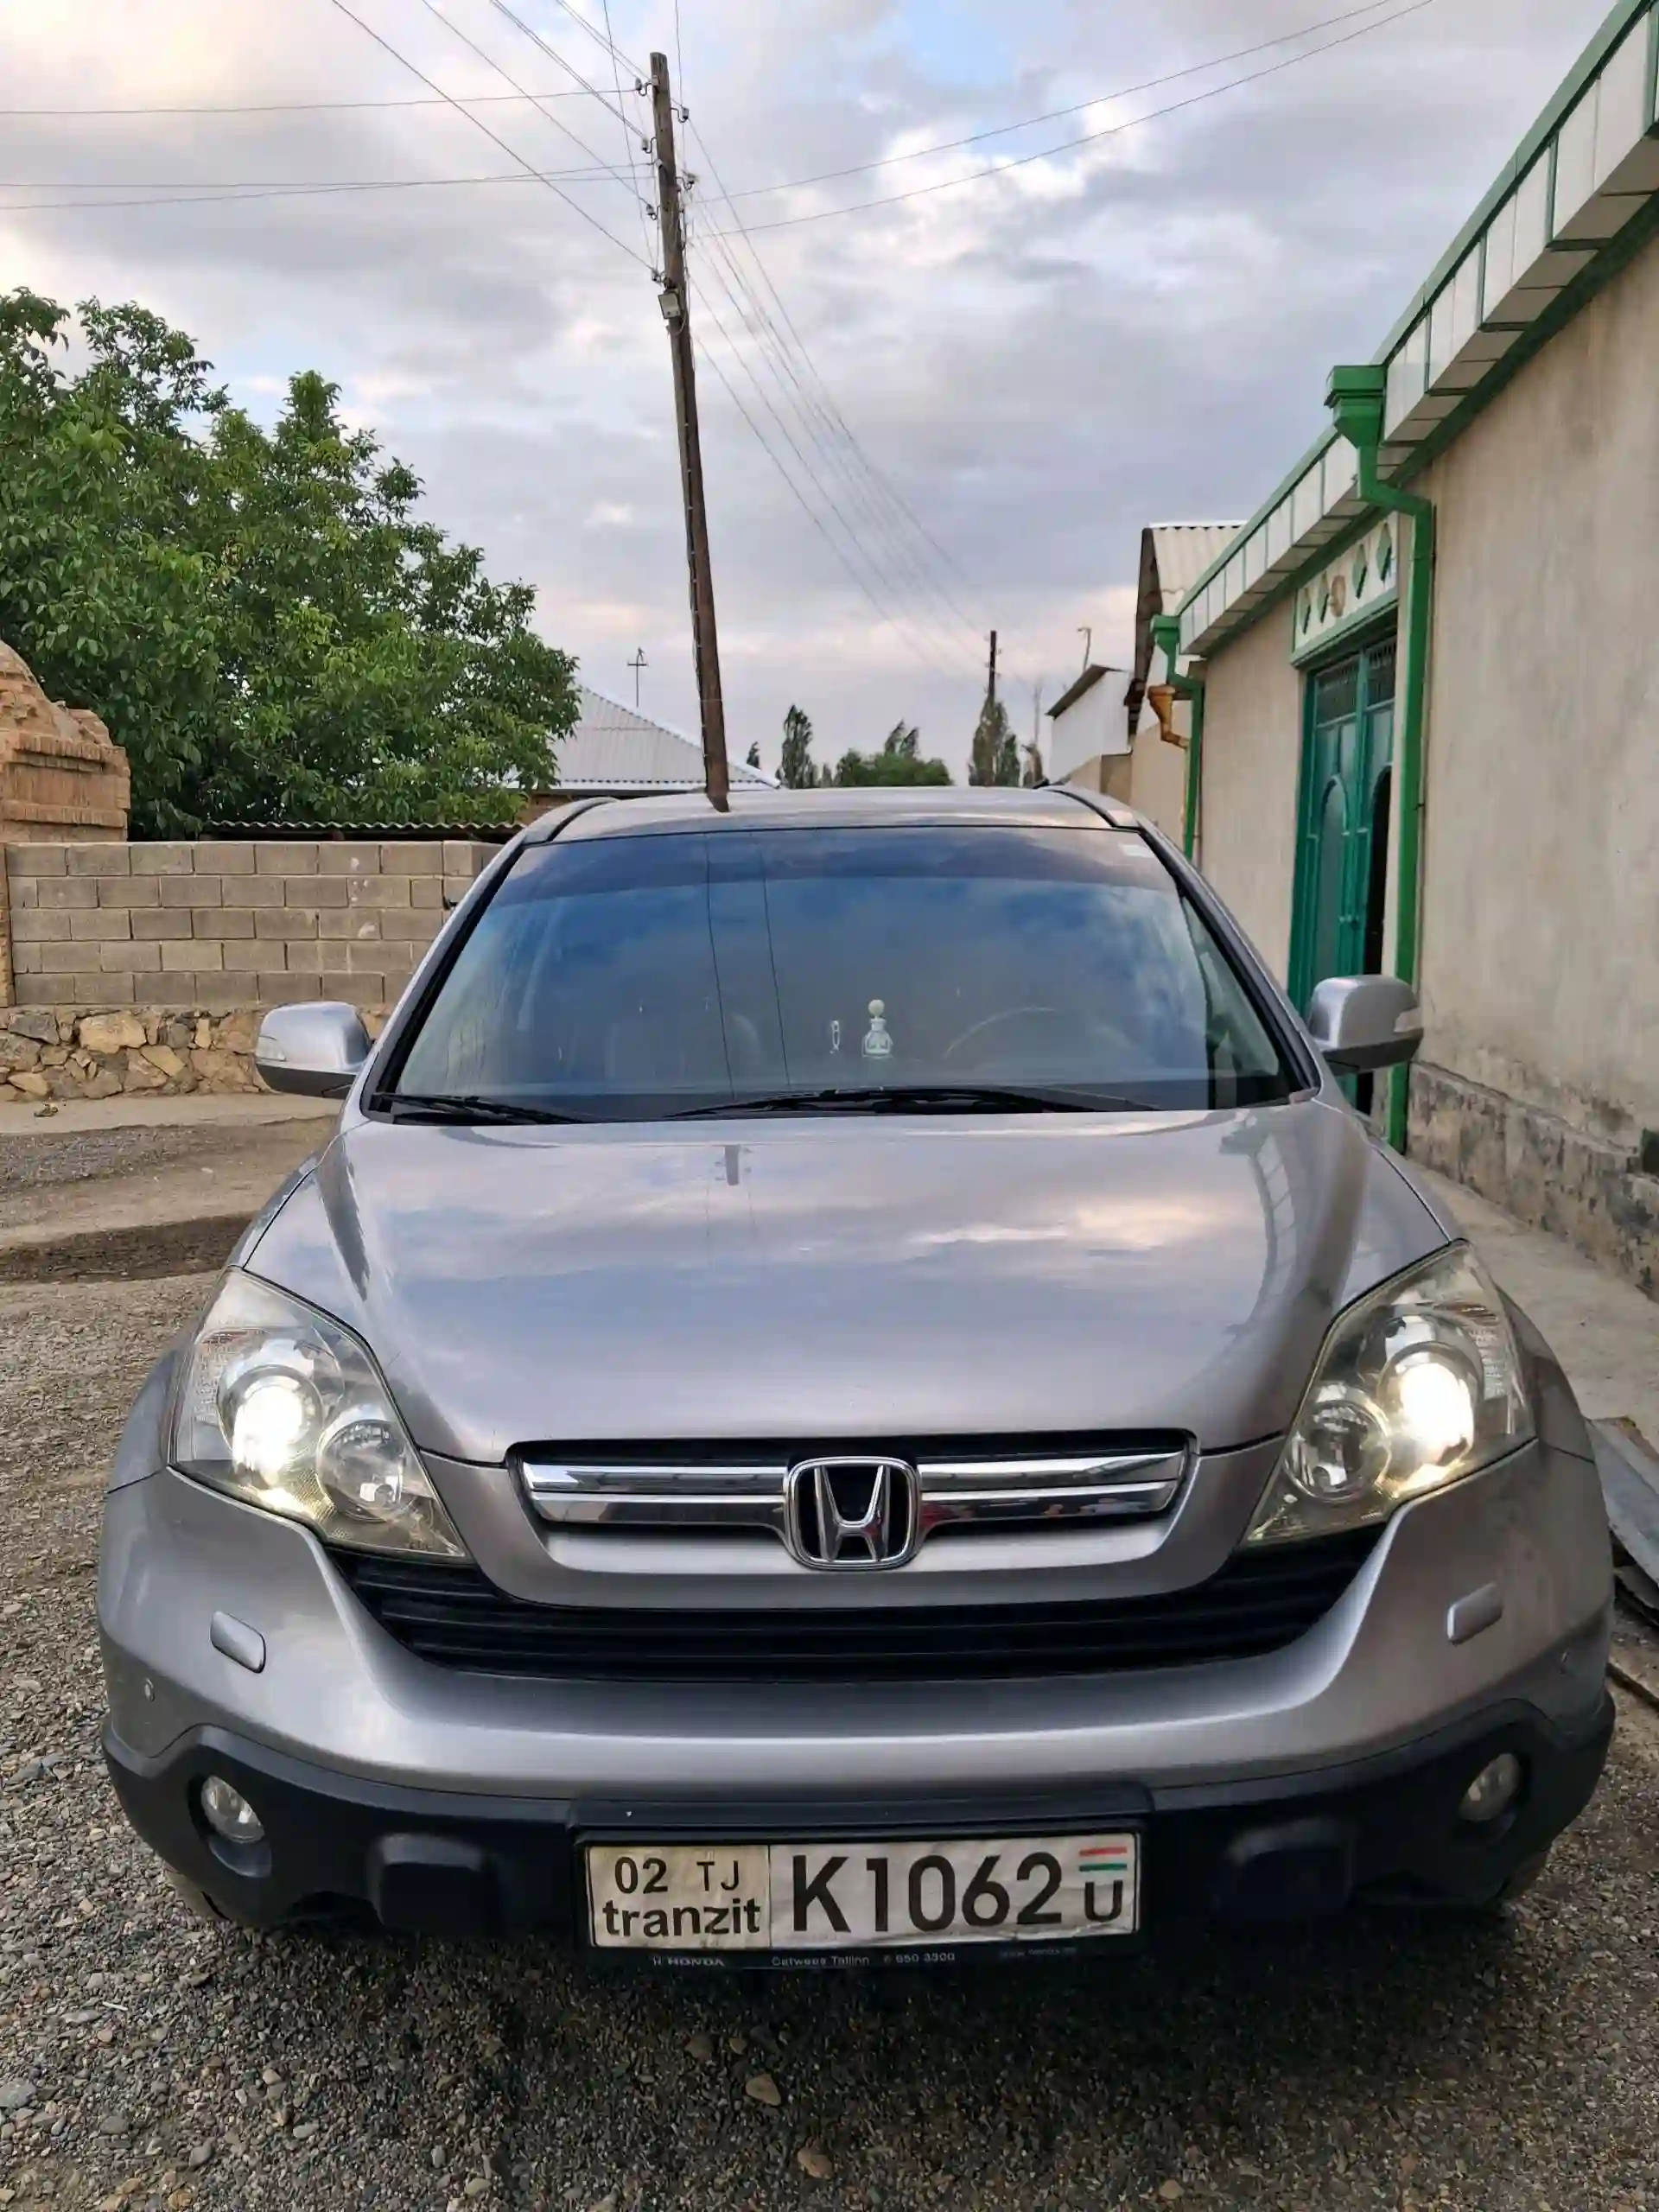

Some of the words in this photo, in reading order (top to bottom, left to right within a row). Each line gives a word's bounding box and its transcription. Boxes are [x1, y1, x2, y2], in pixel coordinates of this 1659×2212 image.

[614, 1856, 669, 1894] 02
[696, 1859, 741, 1892] TJ
[791, 1851, 1063, 1934] K1062
[602, 1897, 762, 1938] tranzit
[1083, 1879, 1123, 1923] U
[667, 1956, 726, 1967] HONDA
[830, 1955, 870, 1967] Tallinn
